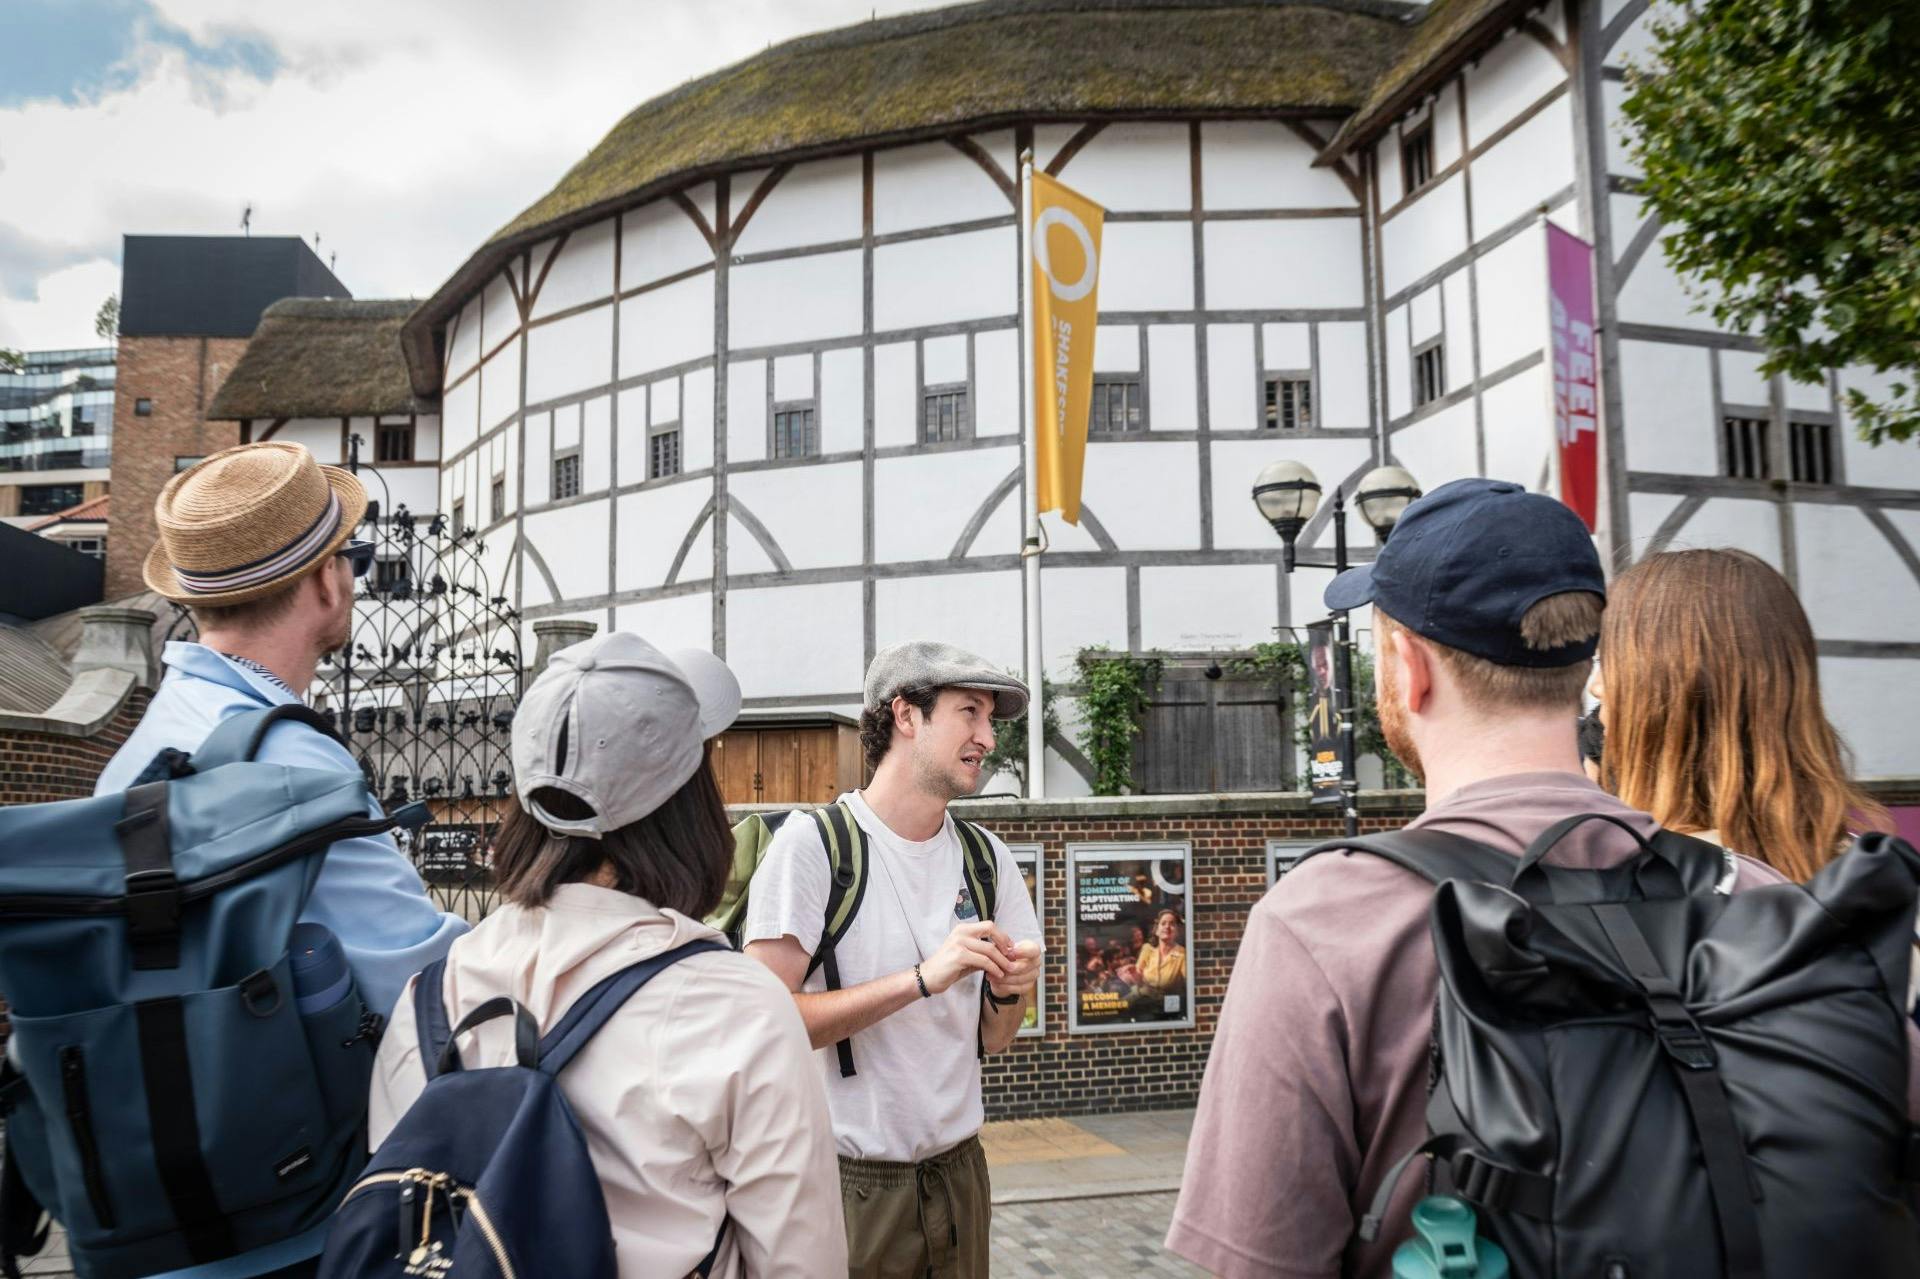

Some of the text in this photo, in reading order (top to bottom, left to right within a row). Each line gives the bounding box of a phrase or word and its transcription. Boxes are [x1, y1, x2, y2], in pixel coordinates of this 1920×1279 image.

[1569, 319, 1596, 443] FEEL
[1080, 876, 1130, 885] BE PART OF
[1080, 886, 1132, 895] SOMETHING
[1080, 894, 1140, 904] CAPTIVATING
[1080, 903, 1122, 912] PLAYFUL
[1080, 912, 1116, 922] UNIQUE
[1082, 992, 1119, 1002] BECOME
[1091, 1000, 1129, 1010] MEMBER
